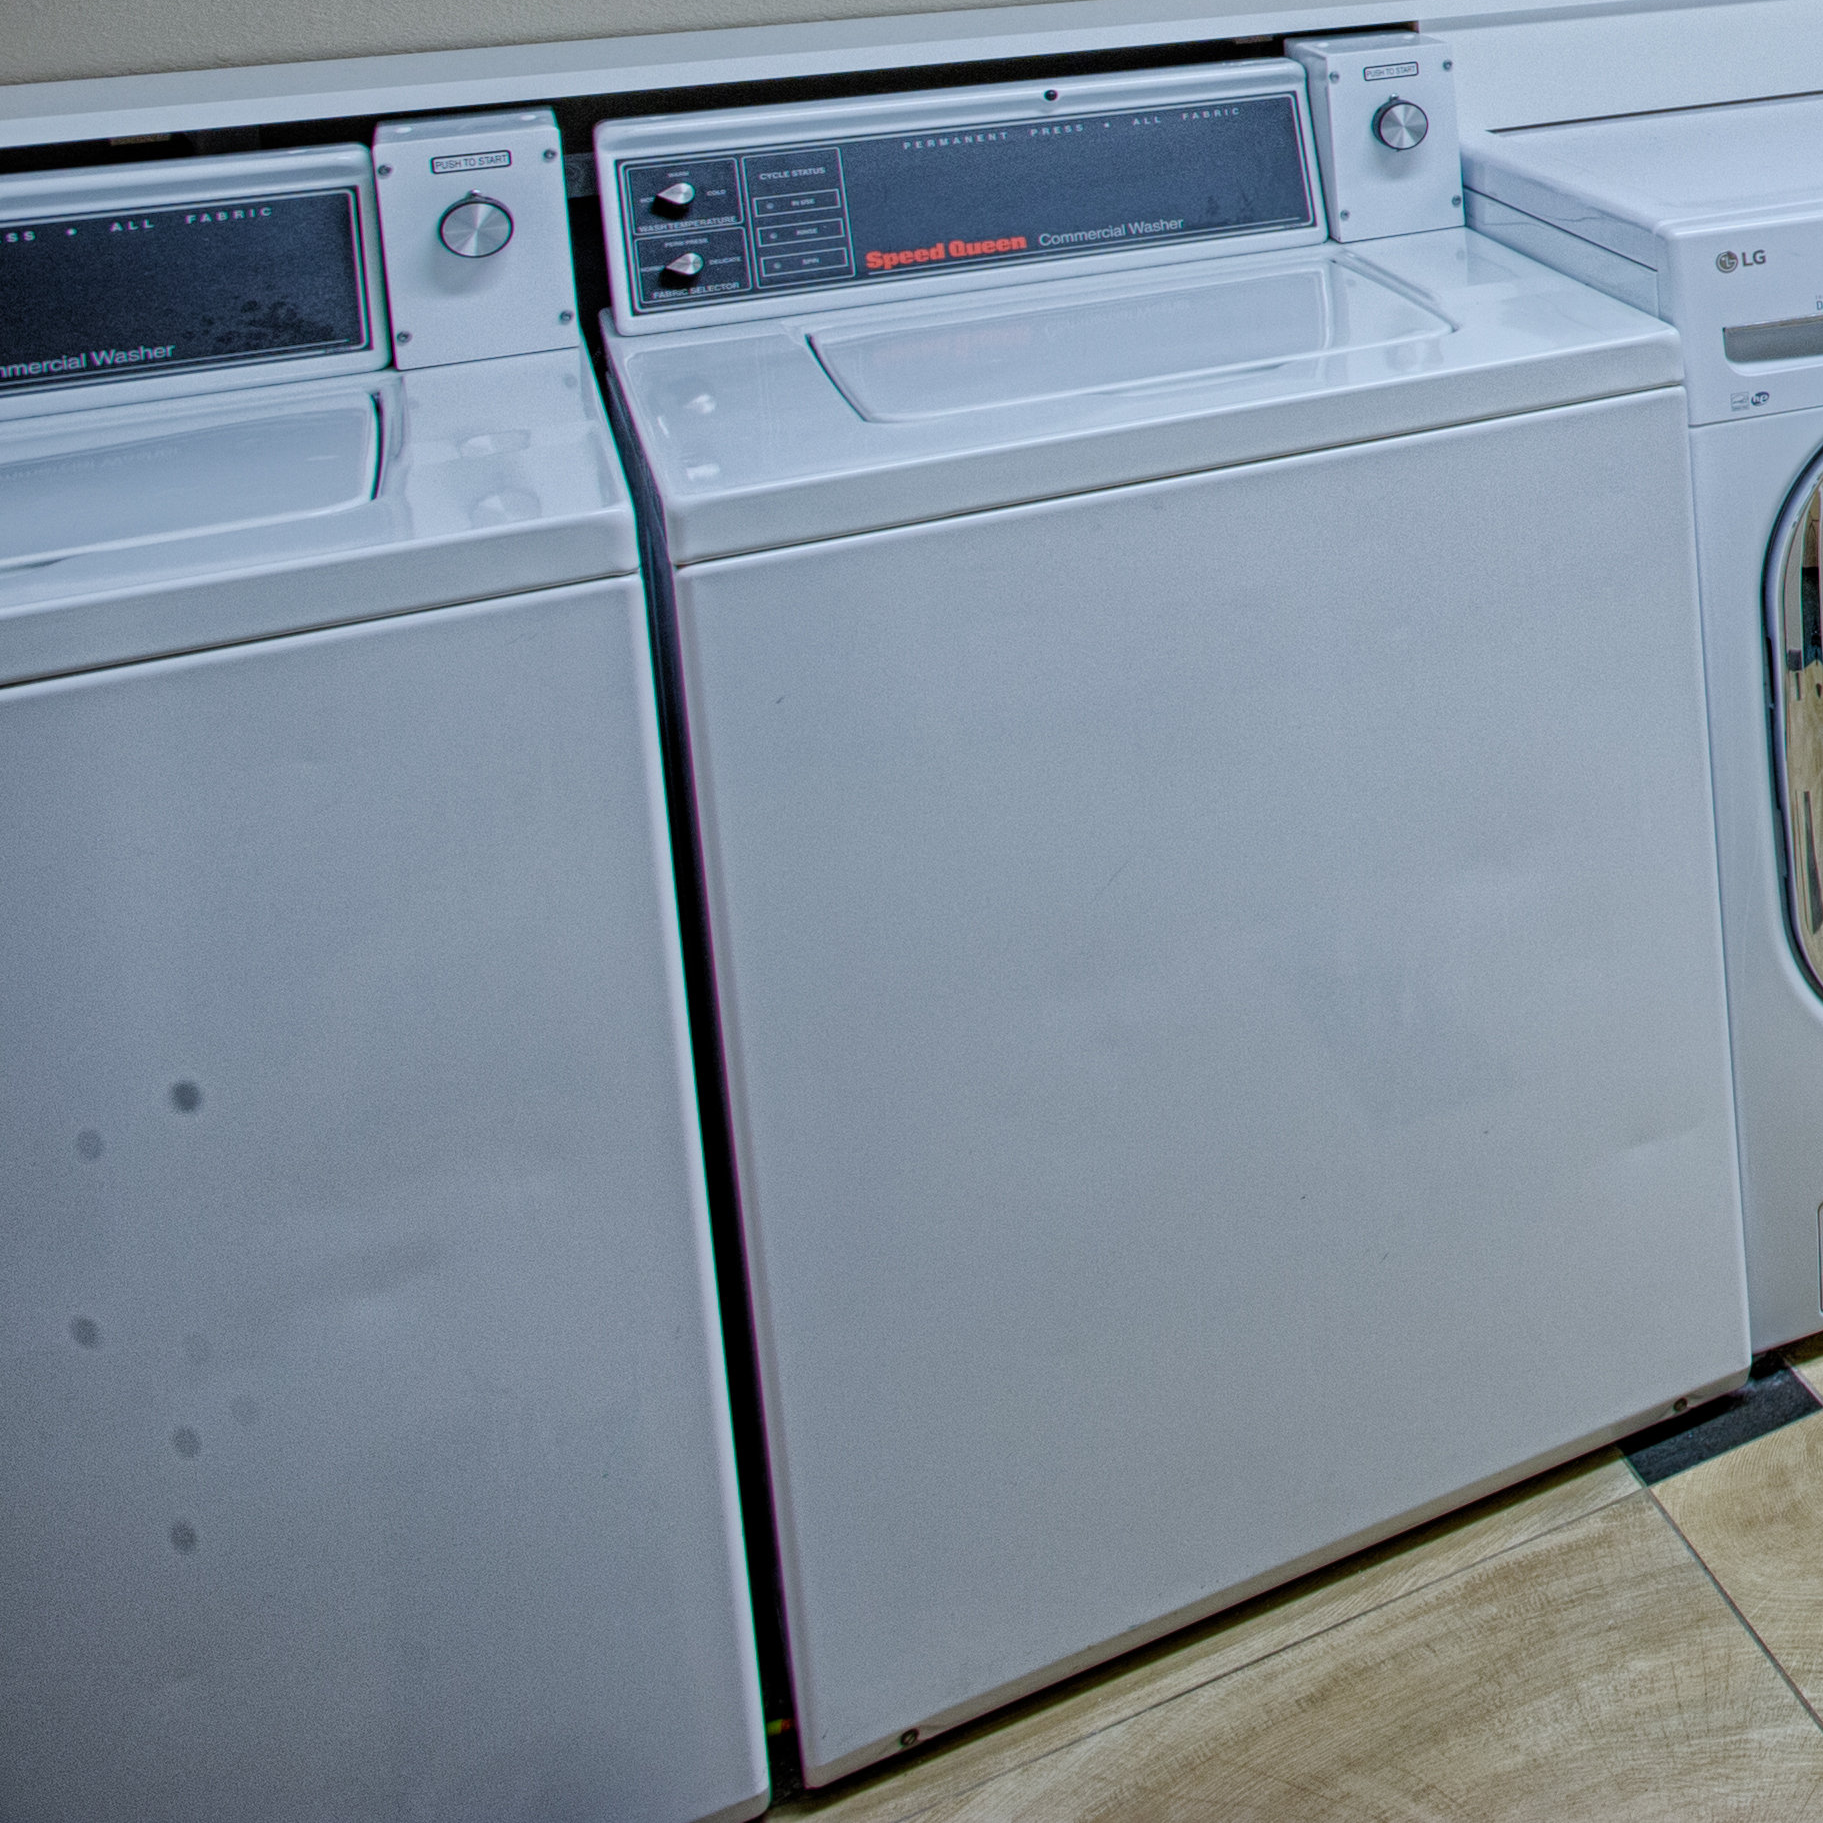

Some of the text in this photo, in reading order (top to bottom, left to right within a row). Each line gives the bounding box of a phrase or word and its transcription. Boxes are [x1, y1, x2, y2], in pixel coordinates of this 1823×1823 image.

[903, 106, 1241, 150] PERMANENT PRESS ALL FABRIC
[435, 154, 507, 170] PUSH TO START
[759, 166, 826, 181] CYCLE STATUS
[110, 218, 155, 232] ALL
[185, 206, 273, 224] FABRIC
[865, 217, 1184, 270] Speed Queen Commercial Washer
[1741, 249, 1767, 268] LG
[652, 281, 740, 300] FABRIC SELECTOR
[91, 344, 176, 367] Washer
